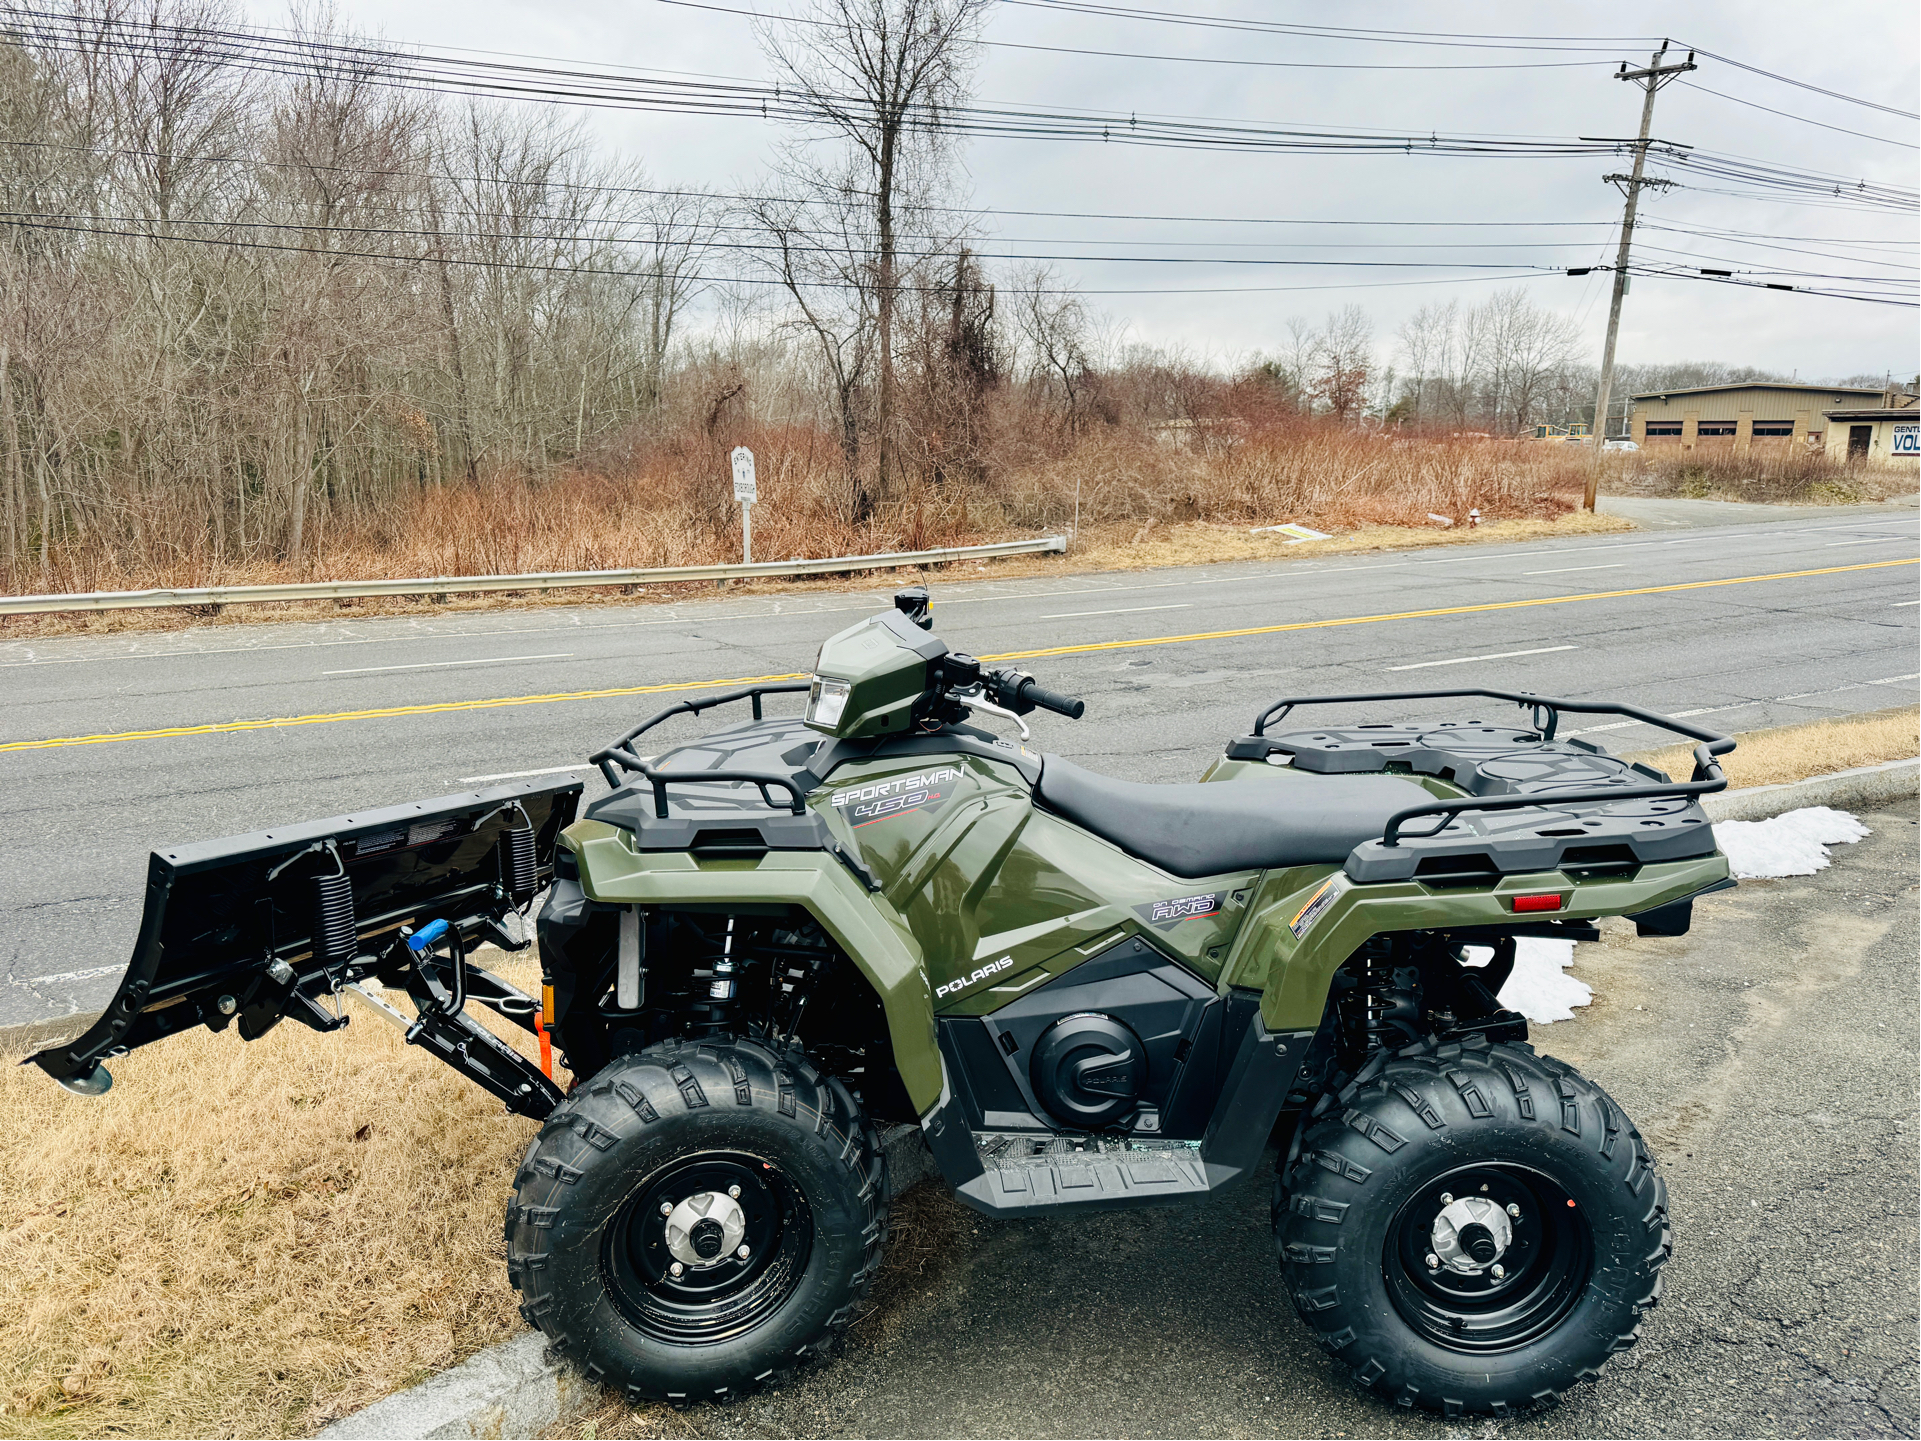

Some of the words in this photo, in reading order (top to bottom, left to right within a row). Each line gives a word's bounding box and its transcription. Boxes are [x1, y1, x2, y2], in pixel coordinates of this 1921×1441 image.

[831, 765, 965, 807] SPORTSMAN
[855, 790, 929, 817] 450
[1152, 899, 1215, 921] AWD
[935, 955, 1014, 999] POLARIS
[466, 1019, 524, 1064] POLARIS
[1085, 1075, 1128, 1085] POLARIS
[784, 1231, 847, 1338] POLARIS
